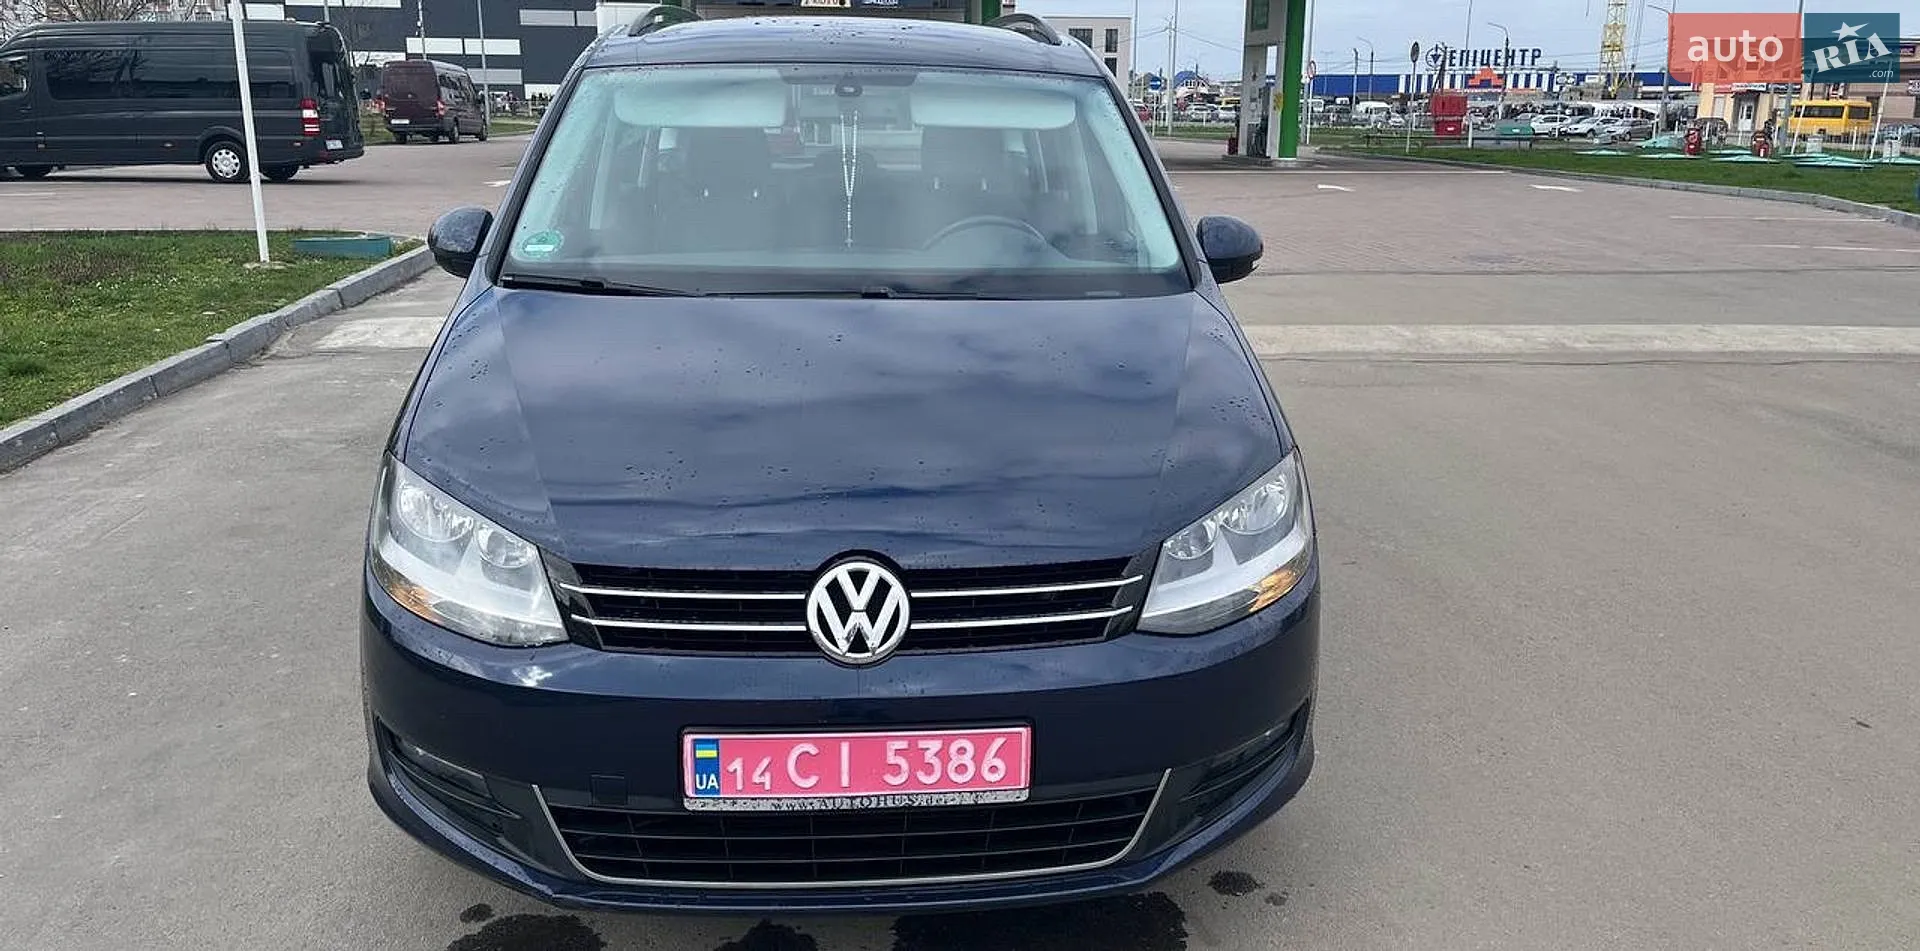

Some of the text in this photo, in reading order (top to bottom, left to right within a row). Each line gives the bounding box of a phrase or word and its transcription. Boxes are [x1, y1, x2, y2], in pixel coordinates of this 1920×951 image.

[1449, 48, 1541, 68] ЕПІЦЕНТР
[882, 737, 1007, 786] 5386
[696, 774, 719, 790] UA
